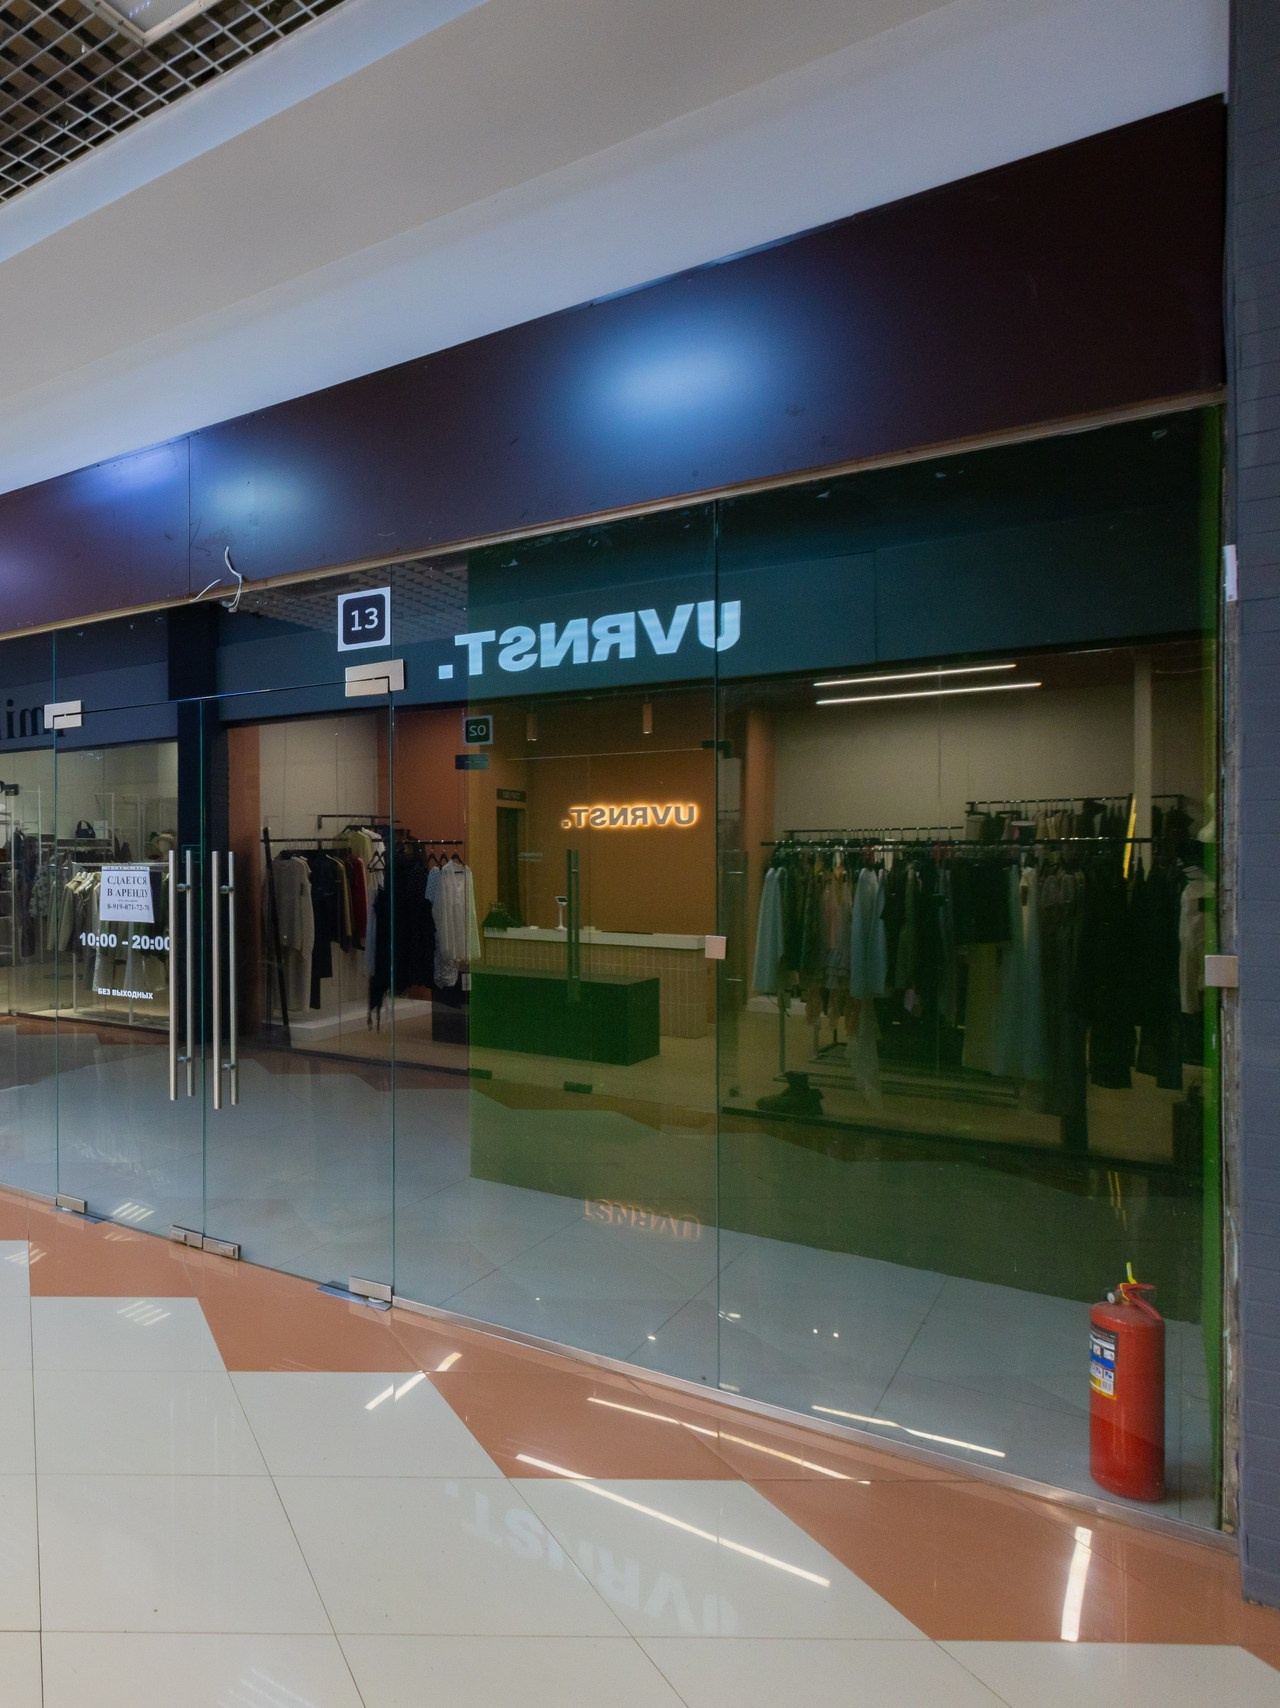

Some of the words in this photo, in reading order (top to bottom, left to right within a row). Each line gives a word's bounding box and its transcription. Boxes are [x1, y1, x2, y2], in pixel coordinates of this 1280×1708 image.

[350, 607, 379, 632] 13
[107, 875, 147, 885] СДАЕТСЯ
[107, 888, 113, 896] В
[115, 888, 148, 898] АРЕНДУ
[79, 932, 117, 948] 10:00
[131, 935, 170, 951] 20:00
[97, 987, 111, 995] БЕЗ
[111, 988, 154, 999] ВЫХОДНЫХ
